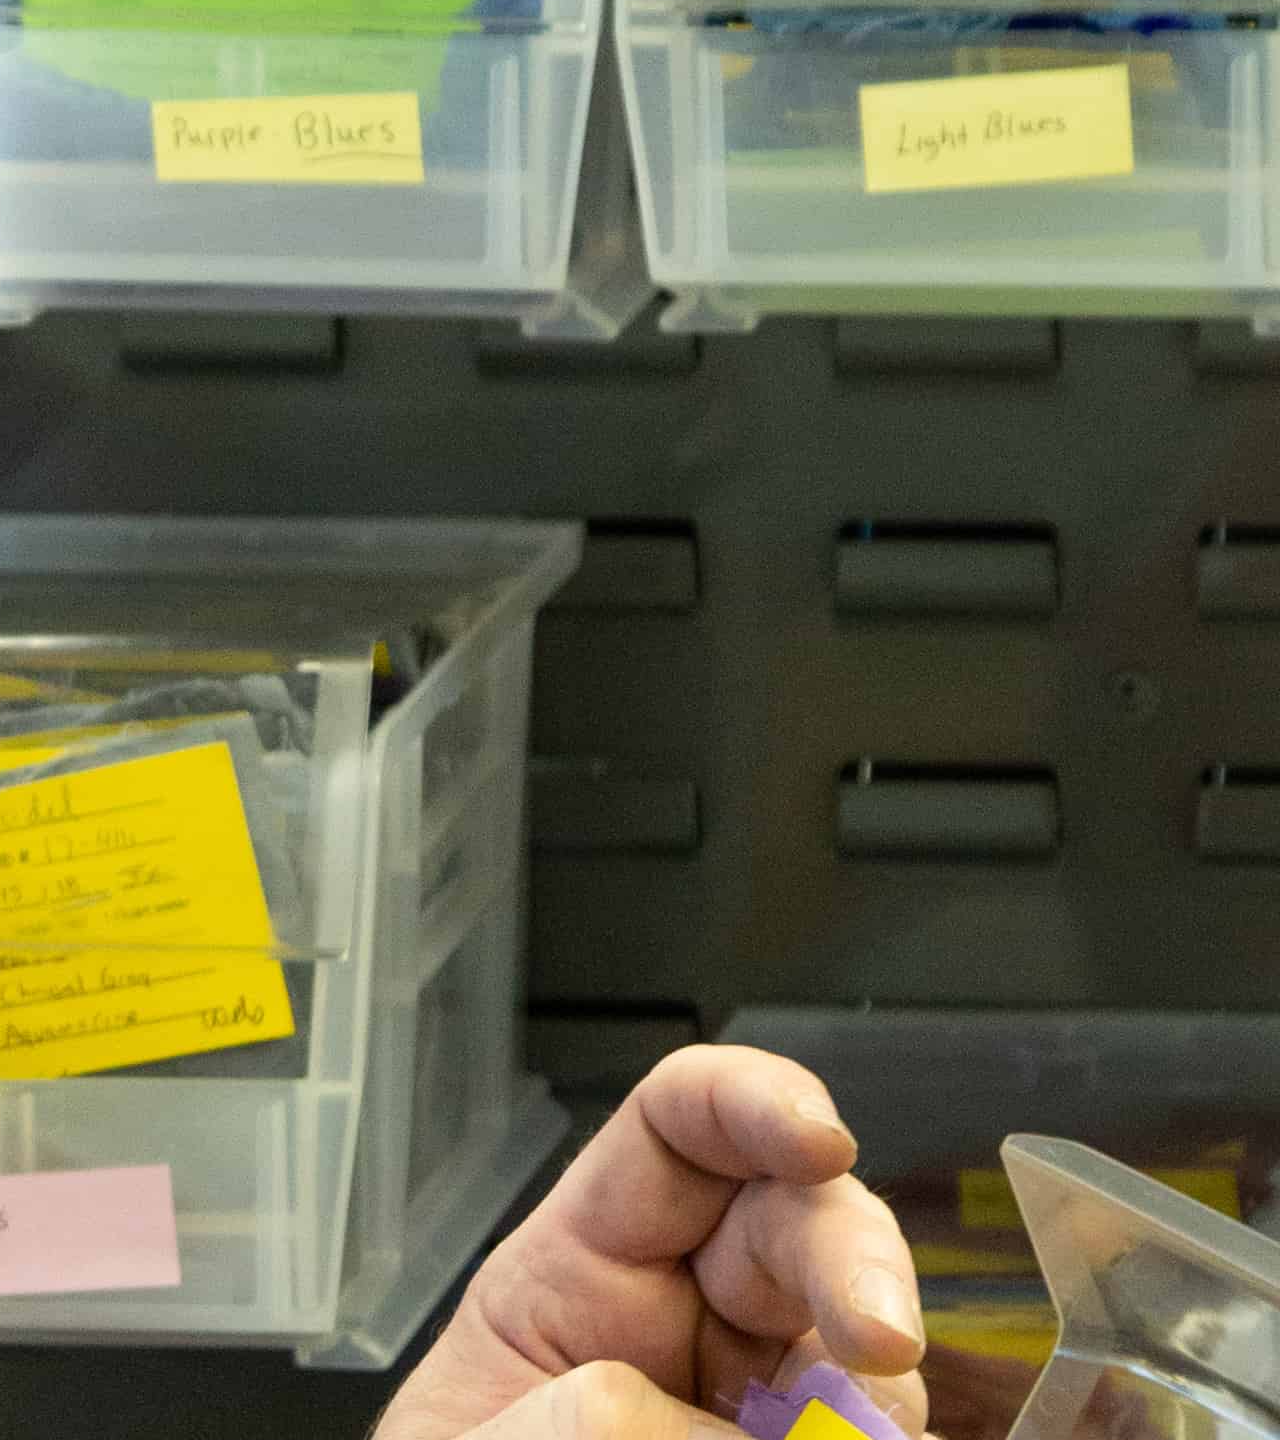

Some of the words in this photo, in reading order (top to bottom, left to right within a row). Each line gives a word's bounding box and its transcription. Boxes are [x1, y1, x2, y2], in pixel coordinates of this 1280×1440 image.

[171, 115, 262, 154] Purple
[294, 109, 398, 152] Blues
[896, 121, 969, 164] Light
[984, 109, 1068, 142] Blues
